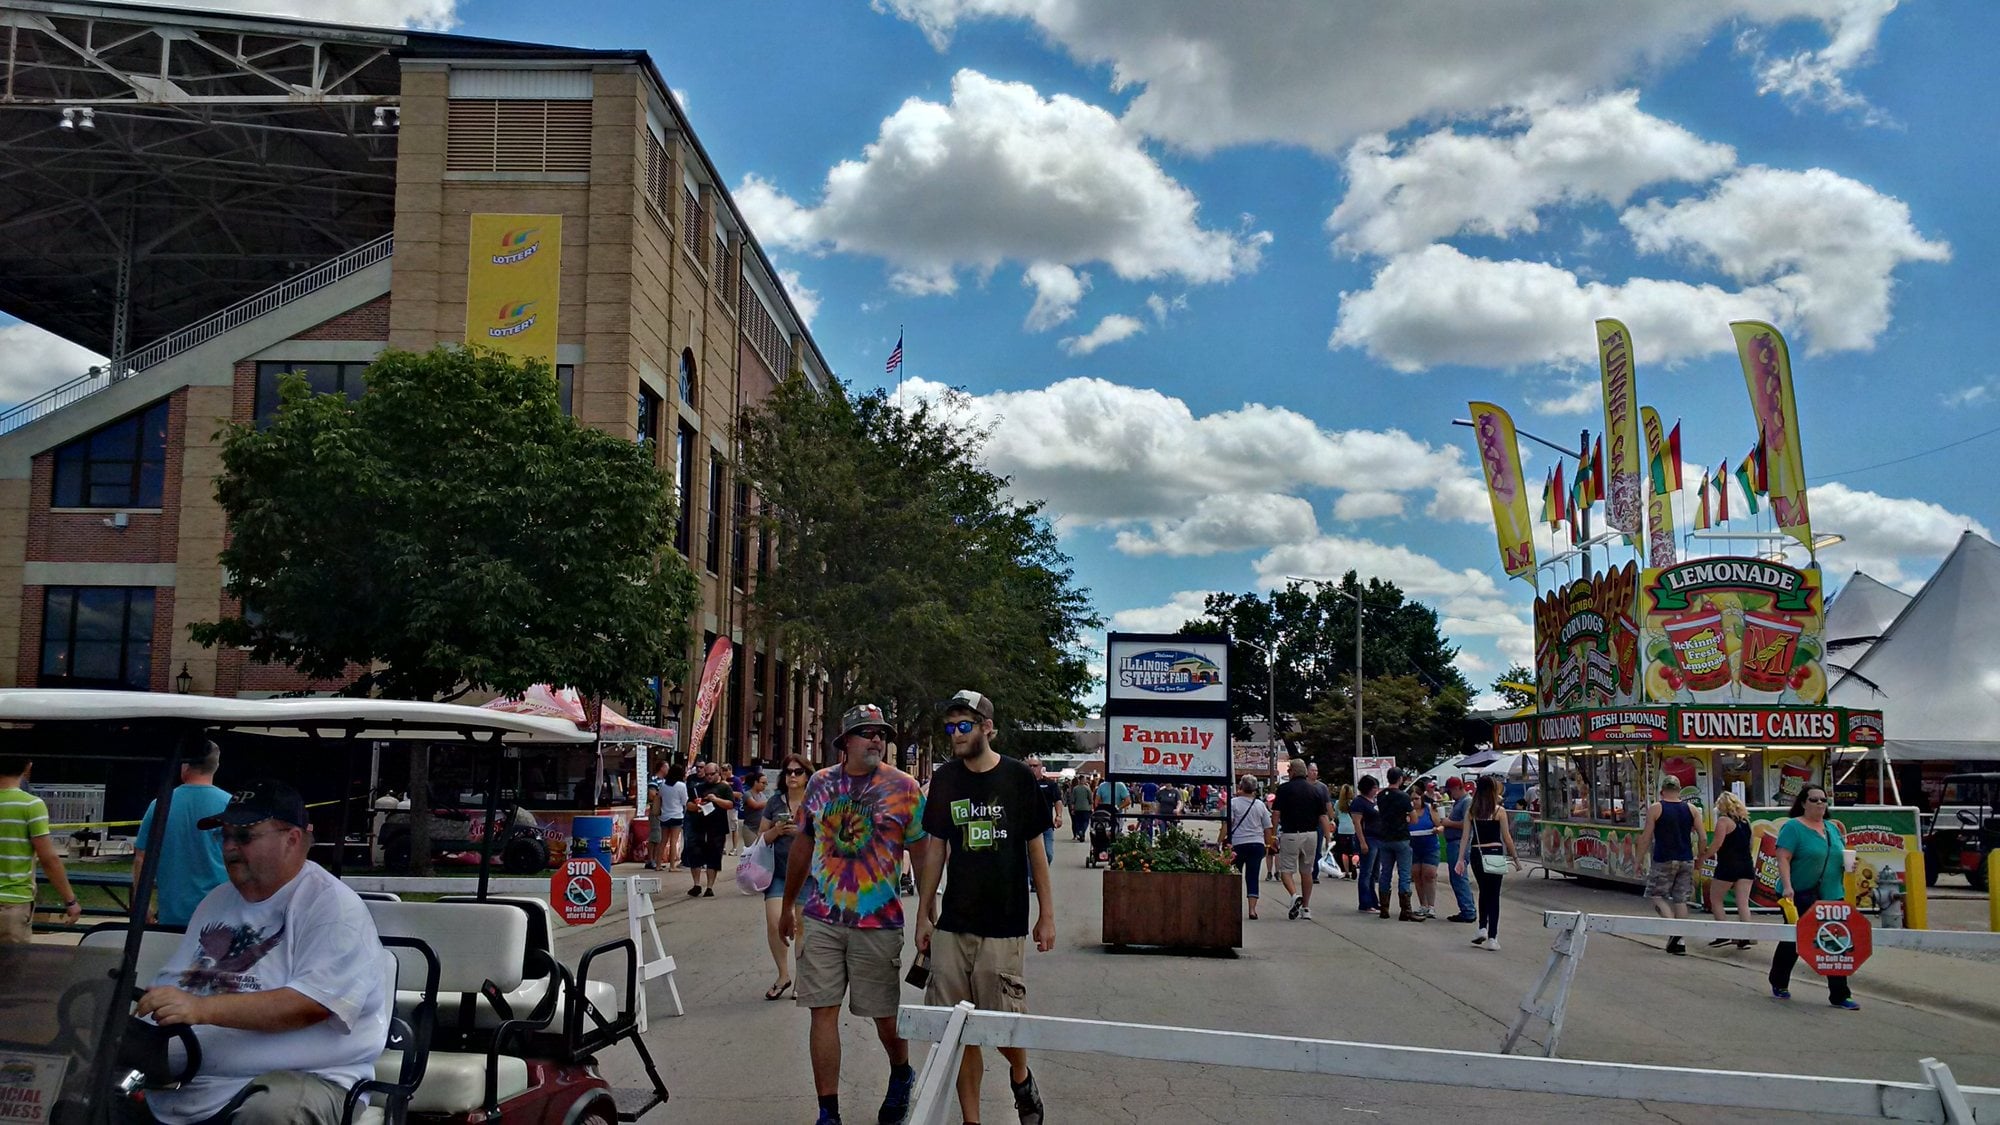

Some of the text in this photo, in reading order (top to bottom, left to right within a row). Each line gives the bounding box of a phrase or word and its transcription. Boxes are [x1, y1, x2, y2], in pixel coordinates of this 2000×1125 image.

[493, 240, 540, 264] LOTTERY
[489, 314, 537, 338] LOTTERY
[1602, 329, 1630, 520] FUNNEL CAKES
[1505, 541, 1533, 571] M
[1667, 562, 1795, 590] LEMONADE
[1569, 597, 1594, 616] JUMBO
[1562, 614, 1603, 643] CORN DOGS
[1120, 656, 1170, 672] ILLINOIS
[1688, 648, 1718, 660] Fresh
[1120, 670, 1189, 687] STATE FAIR
[1591, 712, 1668, 731] FRESH LEMONADE
[1682, 713, 1836, 738] FUNNEL CAKES
[1122, 724, 1214, 750] Family
[1499, 721, 1528, 745] JUMBO
[1142, 746, 1194, 771] Day
[953, 802, 1004, 819] Taking
[971, 825, 1008, 840] Dabs
[567, 861, 597, 876] STOP
[1815, 905, 1851, 921] STOP
[1816, 955, 1825, 963] No
